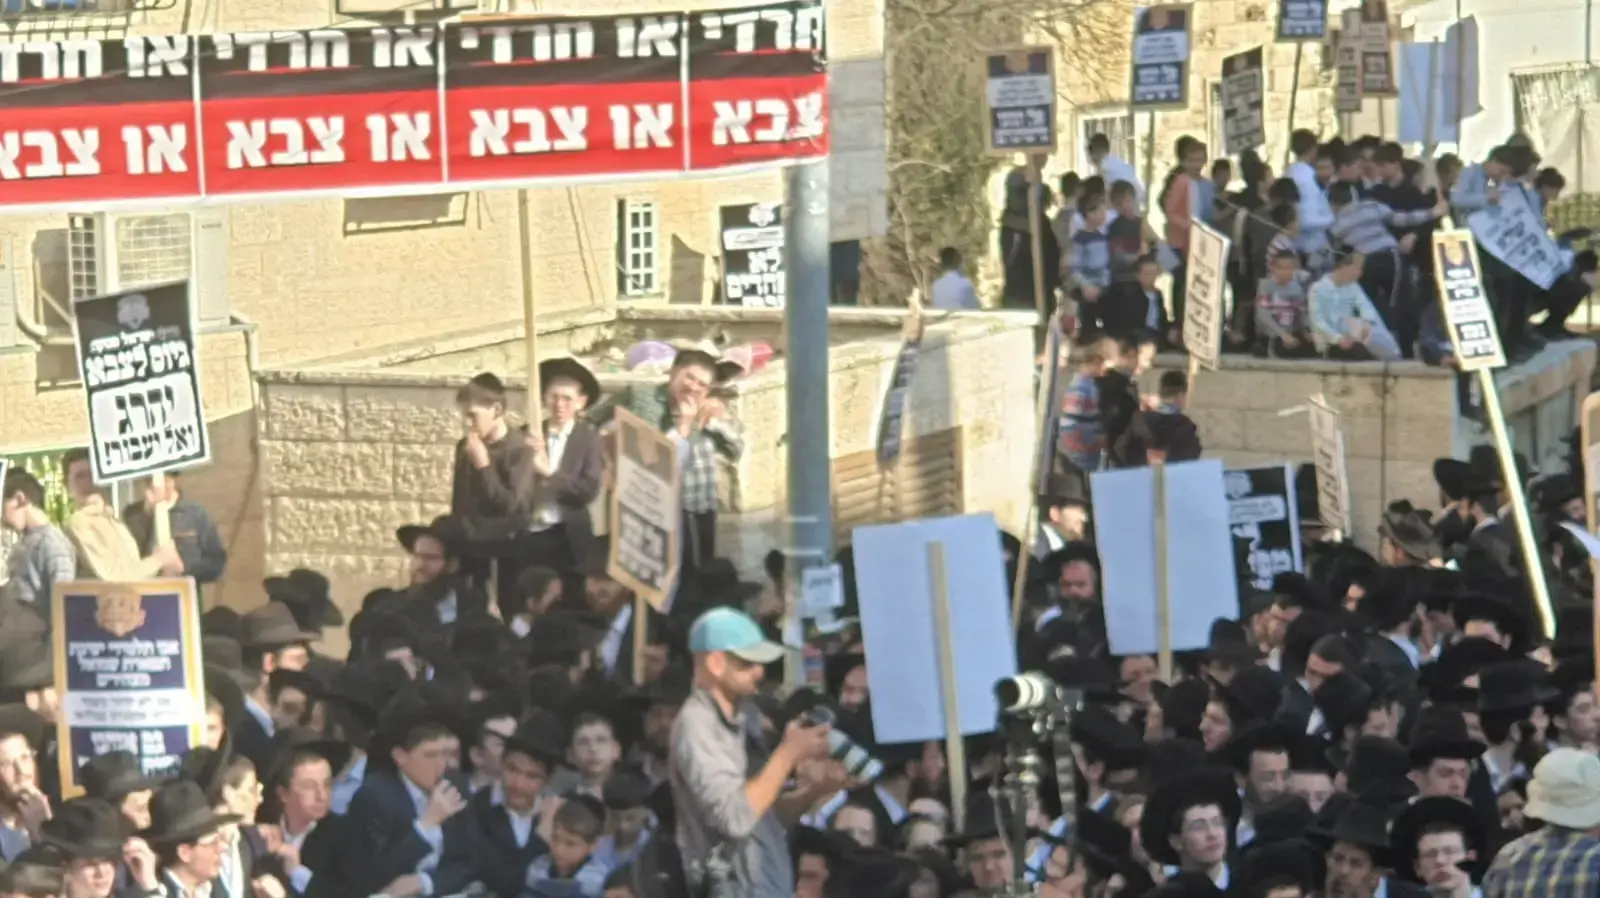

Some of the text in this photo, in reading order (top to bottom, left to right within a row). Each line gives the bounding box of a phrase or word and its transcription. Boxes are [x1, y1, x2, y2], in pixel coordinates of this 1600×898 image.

[124, 36, 189, 78] או
[213, 27, 434, 72] או חרדי
[460, 17, 678, 64] או חרדי
[122, 122, 188, 175] או
[226, 112, 432, 170] או צבא
[469, 102, 674, 157] או צבא
[85, 340, 190, 387] גיוס לצבא
[114, 384, 175, 435] יהרג
[104, 424, 195, 466] ואל יעבור!
